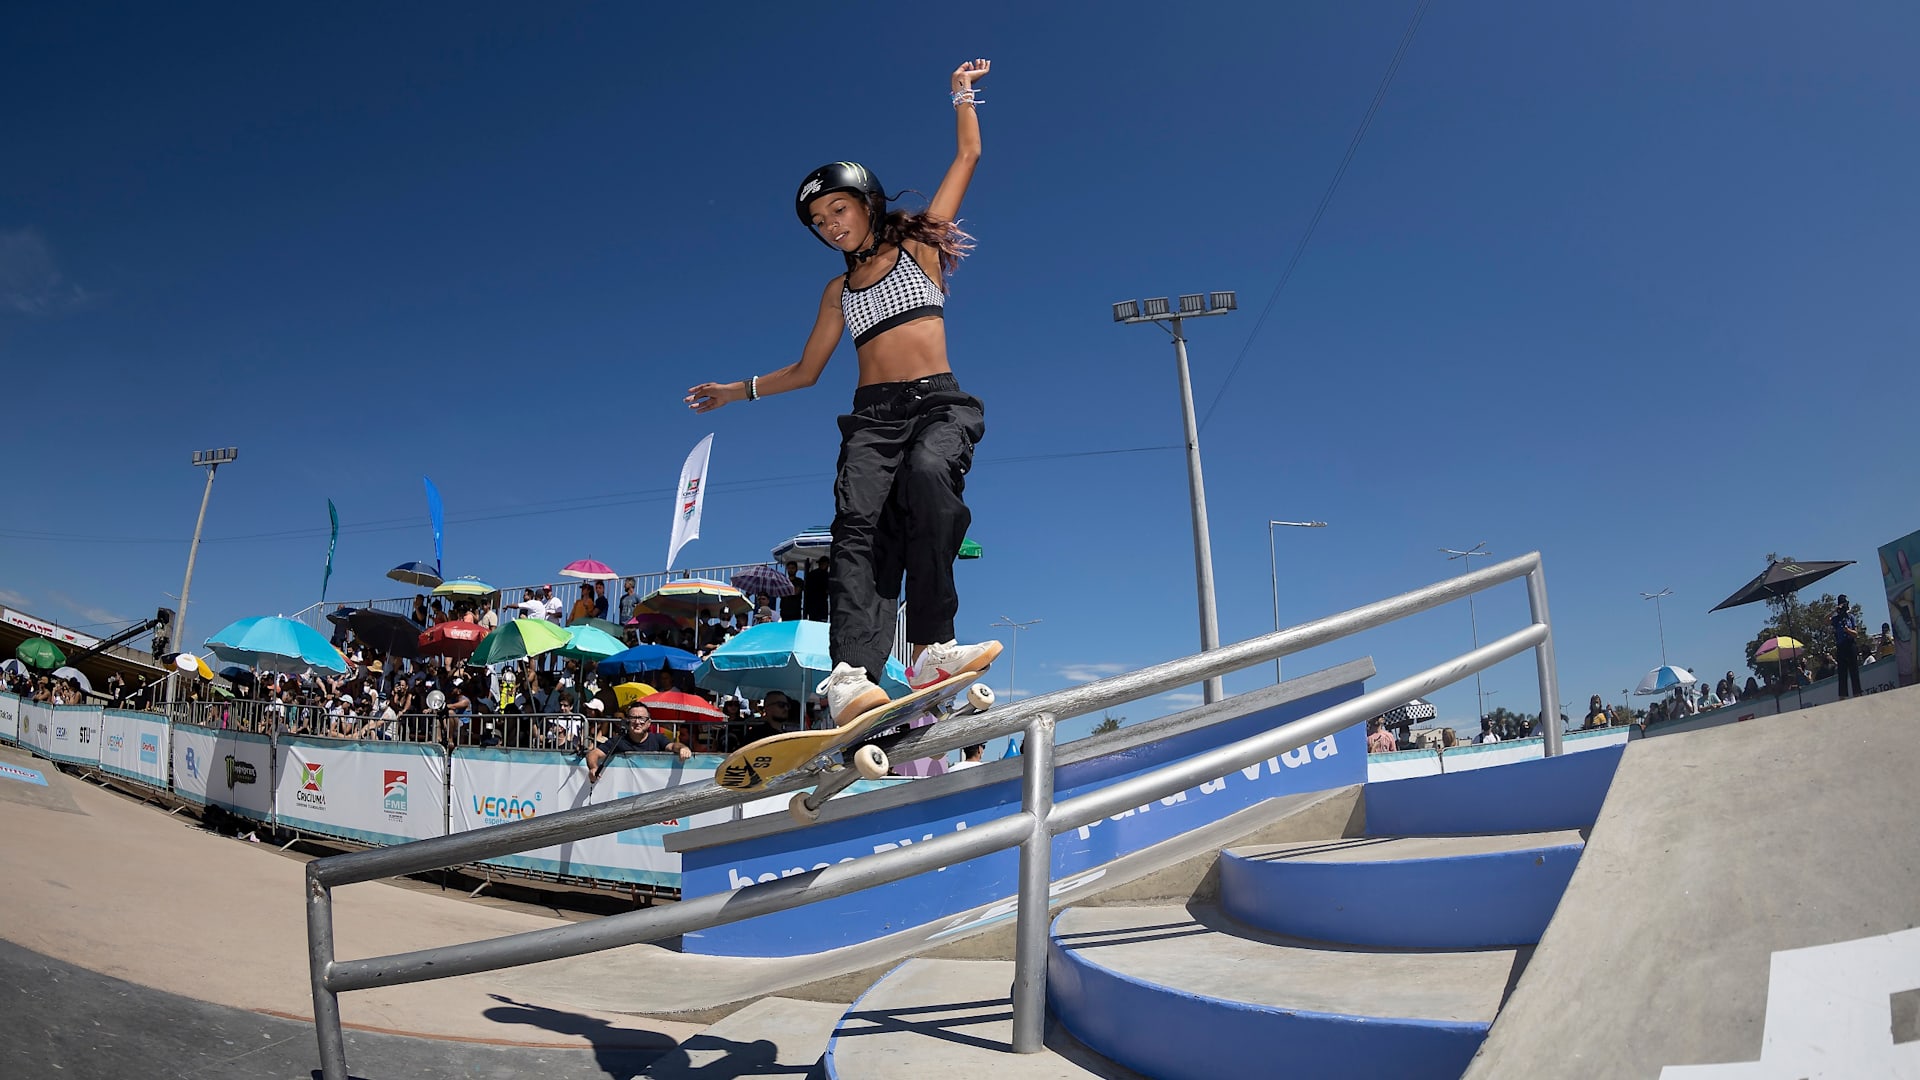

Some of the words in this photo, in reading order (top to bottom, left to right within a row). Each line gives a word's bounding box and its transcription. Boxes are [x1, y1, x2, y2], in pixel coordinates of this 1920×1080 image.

[80, 726, 91, 744] STU
[753, 756, 773, 768] SB
[721, 765, 748, 787] NIKE
[385, 799, 407, 810] FME
[473, 794, 536, 819] VERÃO
